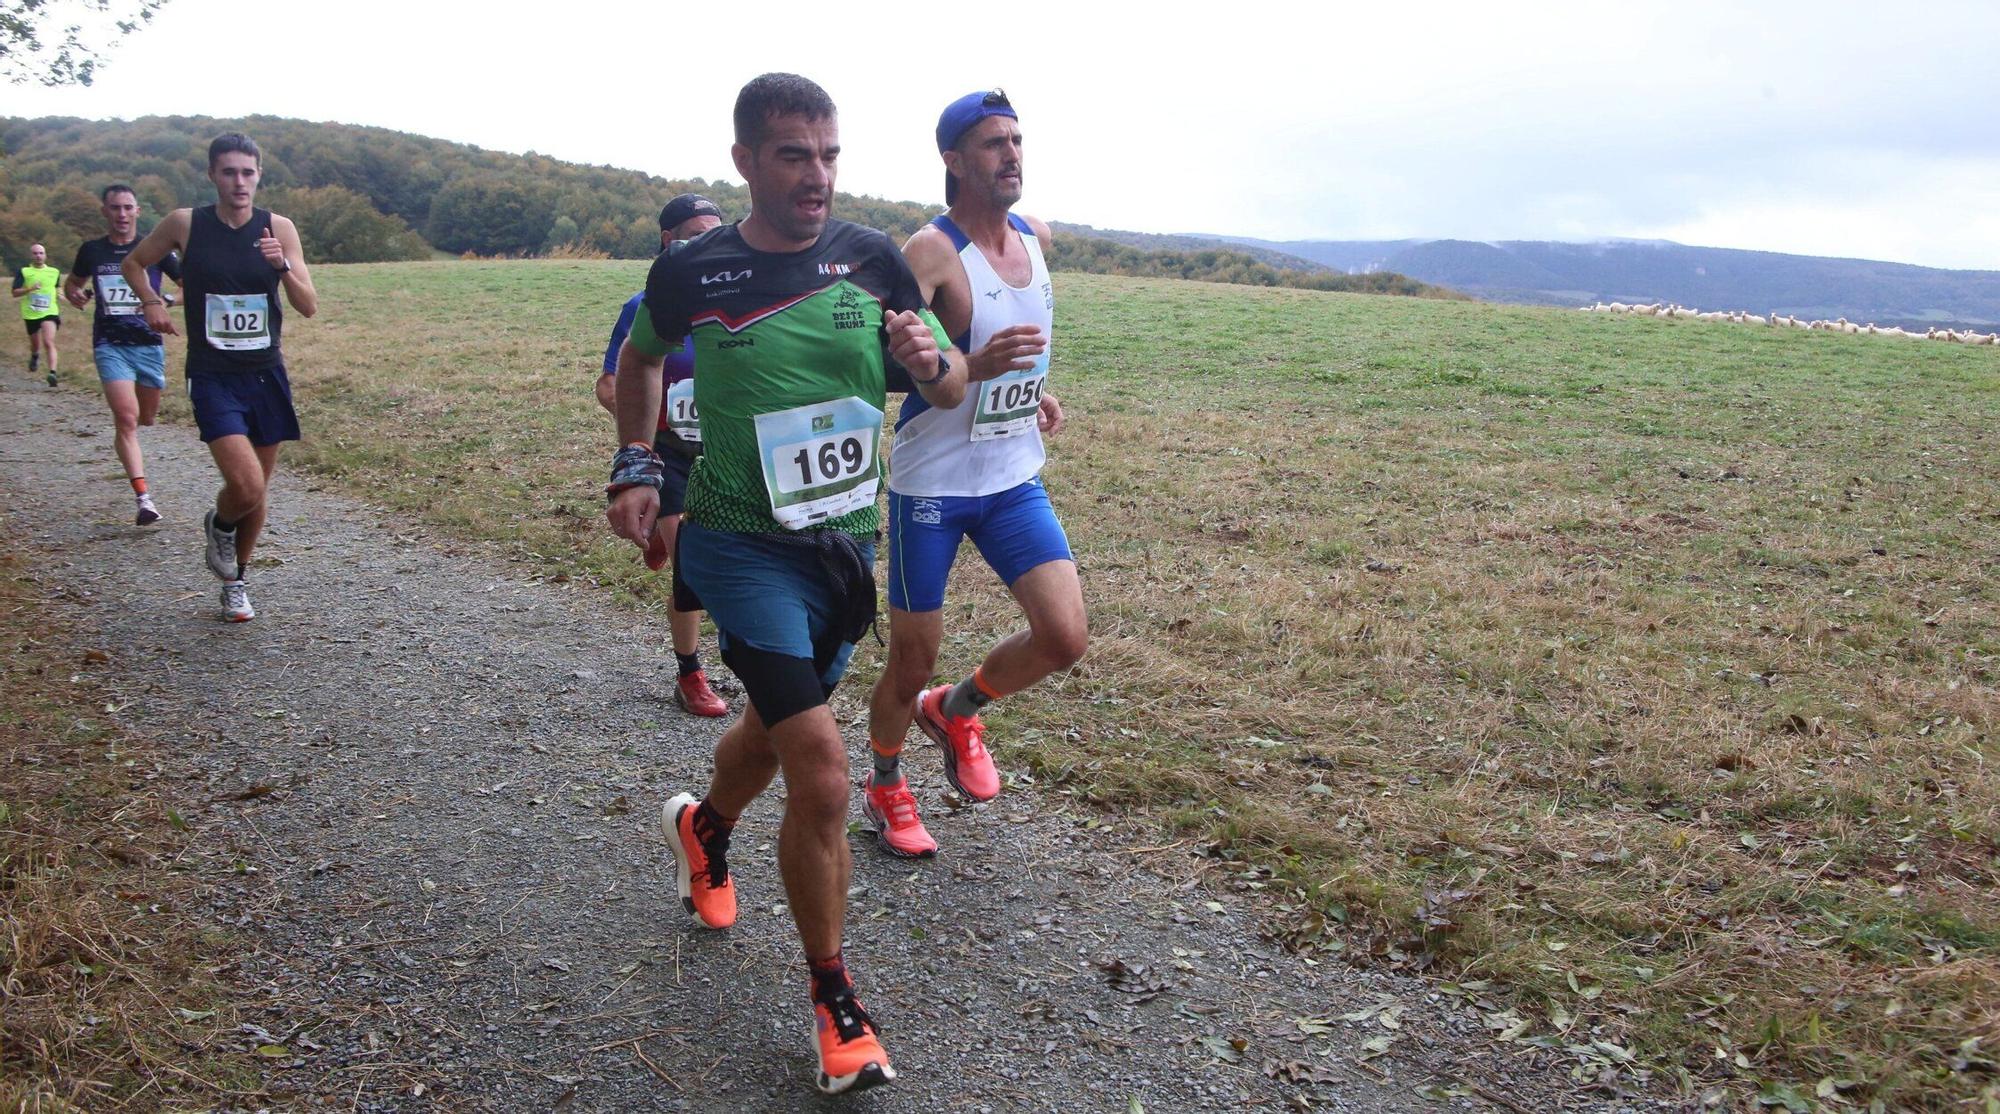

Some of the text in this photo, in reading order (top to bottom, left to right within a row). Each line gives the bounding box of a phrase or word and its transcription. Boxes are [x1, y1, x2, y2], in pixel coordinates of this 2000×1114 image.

[109, 288, 137, 301] 774
[222, 313, 258, 331] 102
[794, 437, 863, 485] 169
